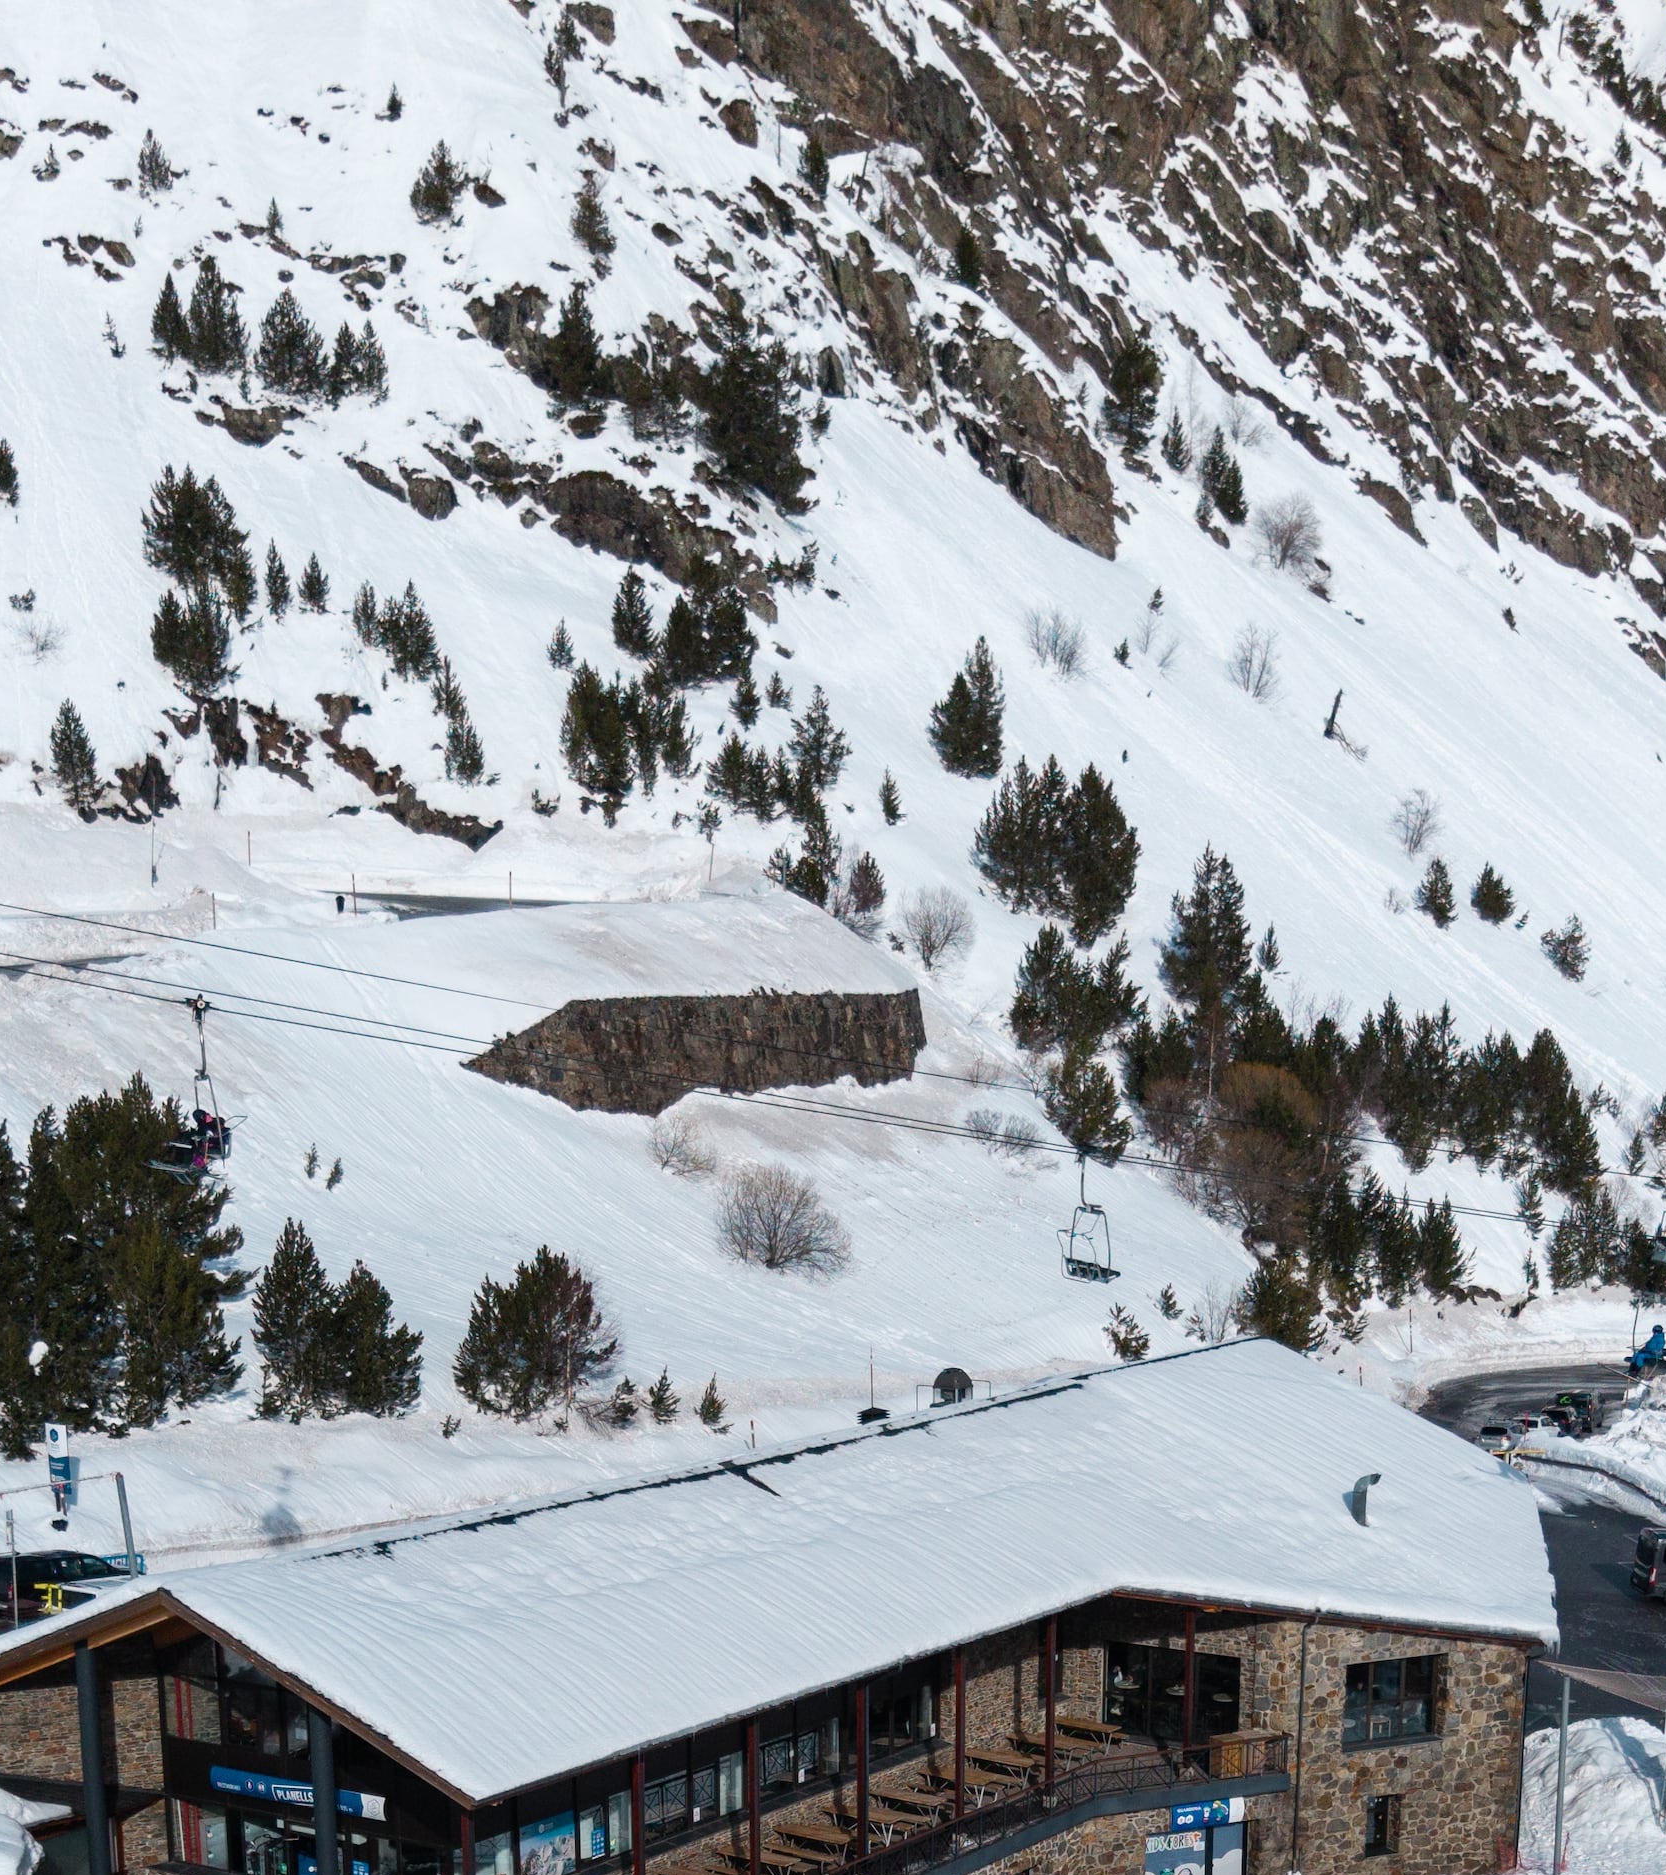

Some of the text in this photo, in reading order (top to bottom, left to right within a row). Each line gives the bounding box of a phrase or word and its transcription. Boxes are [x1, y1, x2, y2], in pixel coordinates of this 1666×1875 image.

[276, 1789, 314, 1803] PLANELLS
[1145, 1831, 1202, 1853] KIDS FOREST
